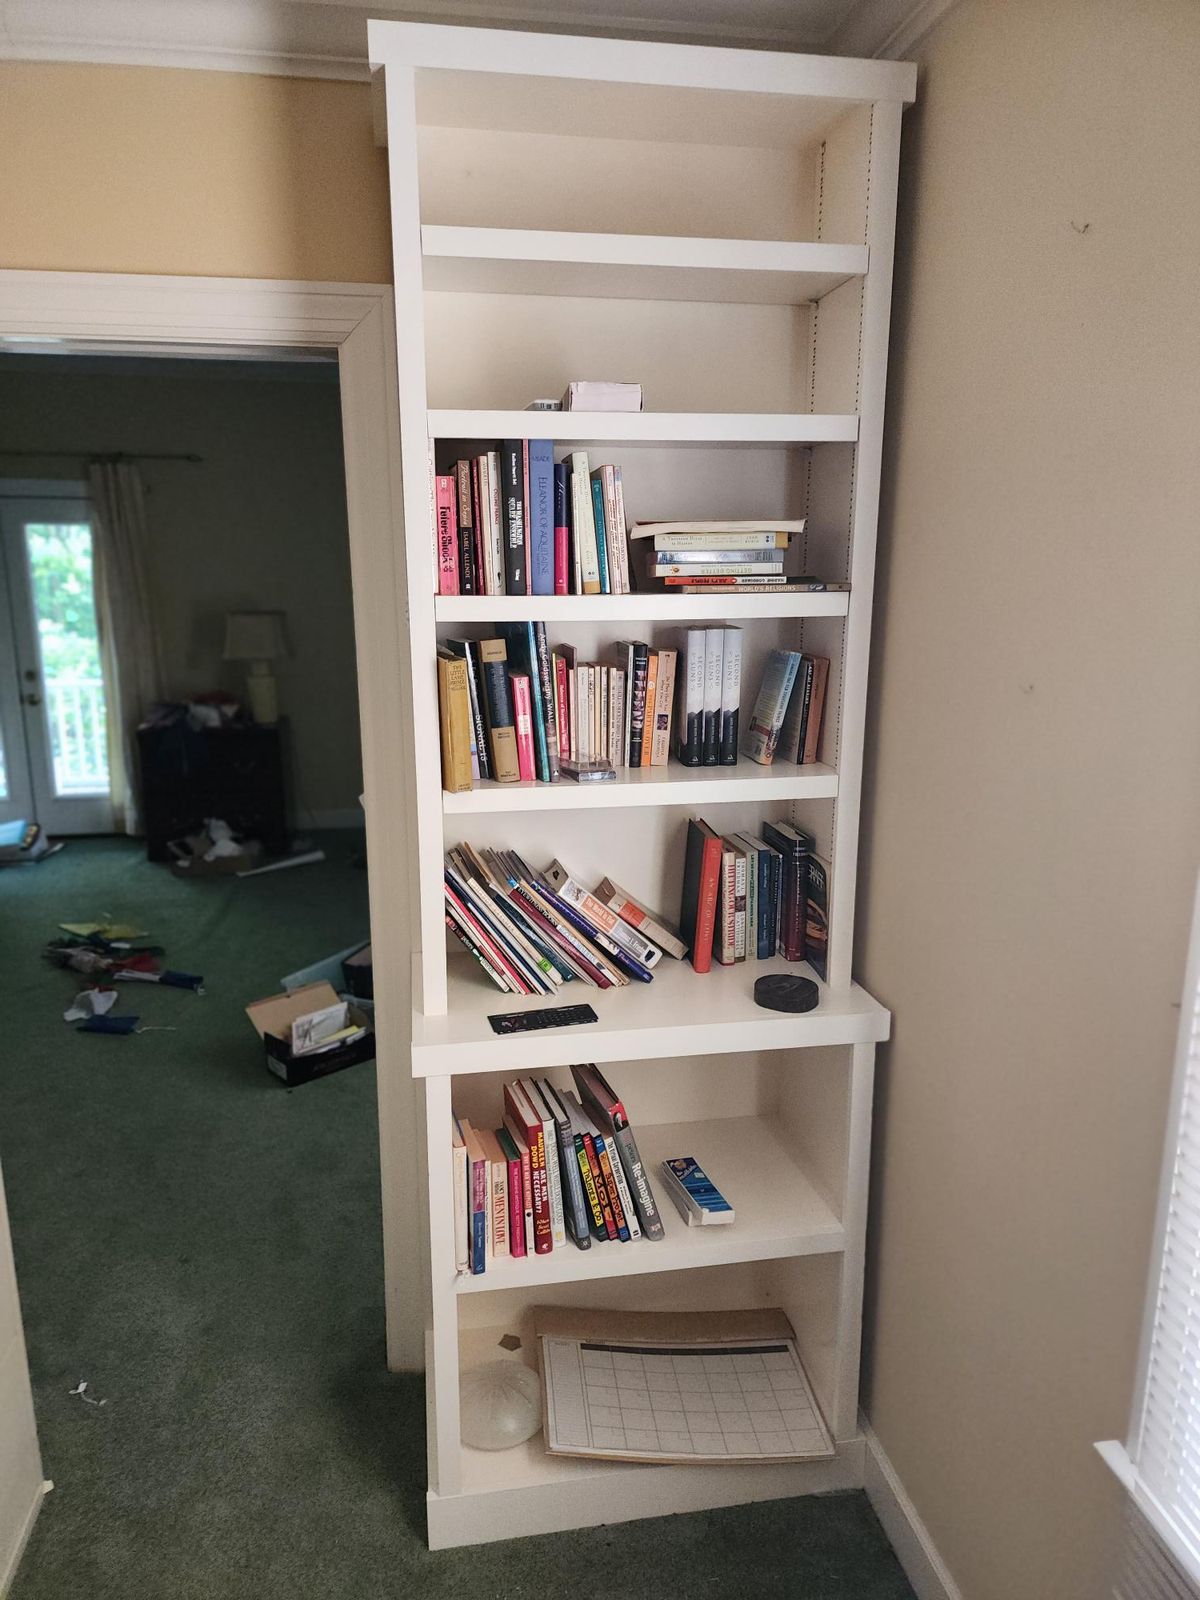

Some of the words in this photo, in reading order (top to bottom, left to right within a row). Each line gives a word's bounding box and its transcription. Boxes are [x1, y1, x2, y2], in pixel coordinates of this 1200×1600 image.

[461, 464, 470, 494] Portrait
[538, 477, 548, 515] ELEANOR
[462, 504, 470, 526] Sepia
[508, 497, 516, 518] SQUARE
[440, 506, 451, 535] Future
[540, 518, 548, 529] OF
[509, 520, 517, 548] ENSEMBLE
[538, 530, 549, 575] AQUITAINE
[539, 634, 547, 649] Andy
[540, 652, 552, 700] Goldsworthy
[708, 878, 715, 888] AN
[703, 922, 711, 943] LOVE
[537, 1132, 545, 1167] MAUREEN
[533, 1171, 542, 1214] NECESSARY?
[540, 1186, 548, 1202] MEN
[606, 1173, 616, 1195] Super
[631, 1162, 655, 1216] Re-imagine
[495, 1196, 504, 1214] MEN
[584, 1169, 596, 1201] Talents
[594, 1210, 602, 1224] Co.
[496, 1216, 505, 1224] IN
[496, 1227, 505, 1245] LOVE
